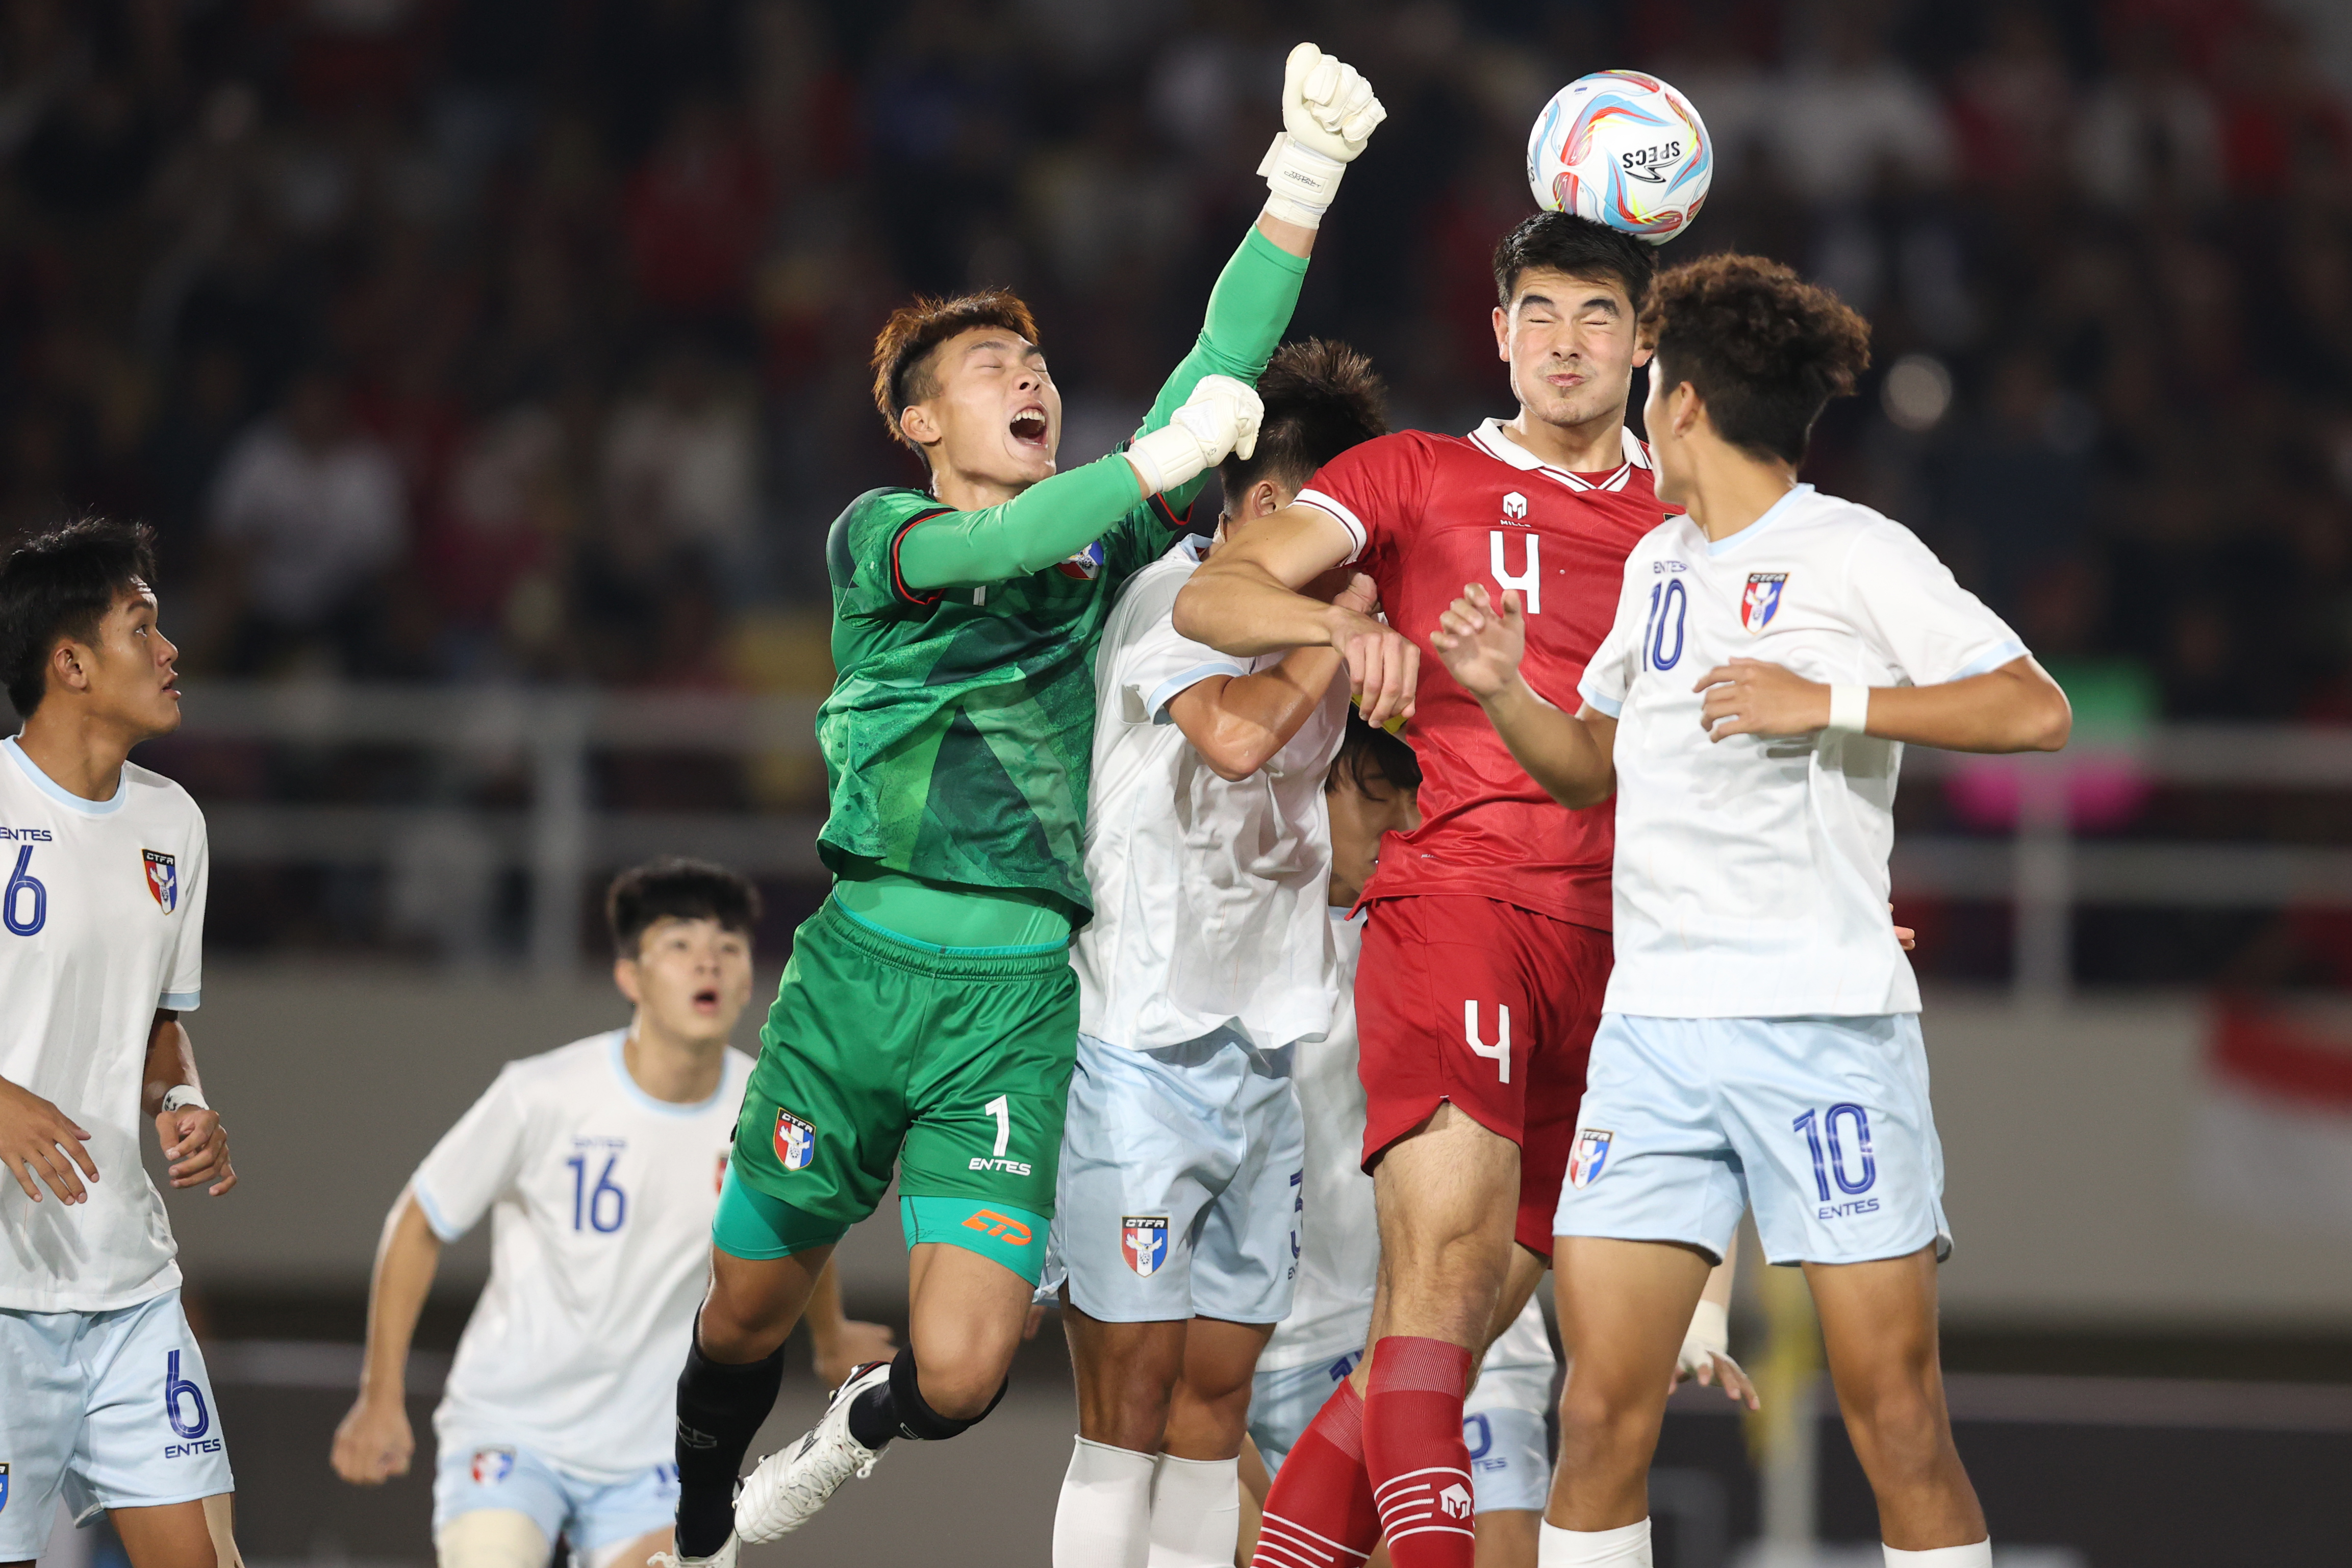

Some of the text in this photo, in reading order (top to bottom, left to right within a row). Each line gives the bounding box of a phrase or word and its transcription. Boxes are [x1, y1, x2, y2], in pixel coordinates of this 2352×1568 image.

[1623, 141, 1680, 168] SPECS
[1490, 530, 1540, 614] 4
[1654, 561, 1688, 573] ENTES
[1642, 578, 1687, 672] 10
[0, 827, 52, 842] ENTES
[146, 852, 174, 865] CTFA
[3, 845, 47, 937] 6
[1464, 999, 1510, 1084] 4
[781, 1112, 813, 1133] CTFA
[984, 1094, 1010, 1157] 1
[1792, 1102, 1876, 1202] 10
[969, 1157, 1031, 1176] ENTES
[566, 1153, 625, 1233] 16
[1818, 1198, 1880, 1219] ENTES
[1125, 1219, 1165, 1228] CTFA
[166, 1349, 209, 1439] 6
[165, 1438, 221, 1459] ENTES
[1472, 1457, 1507, 1472] TES
